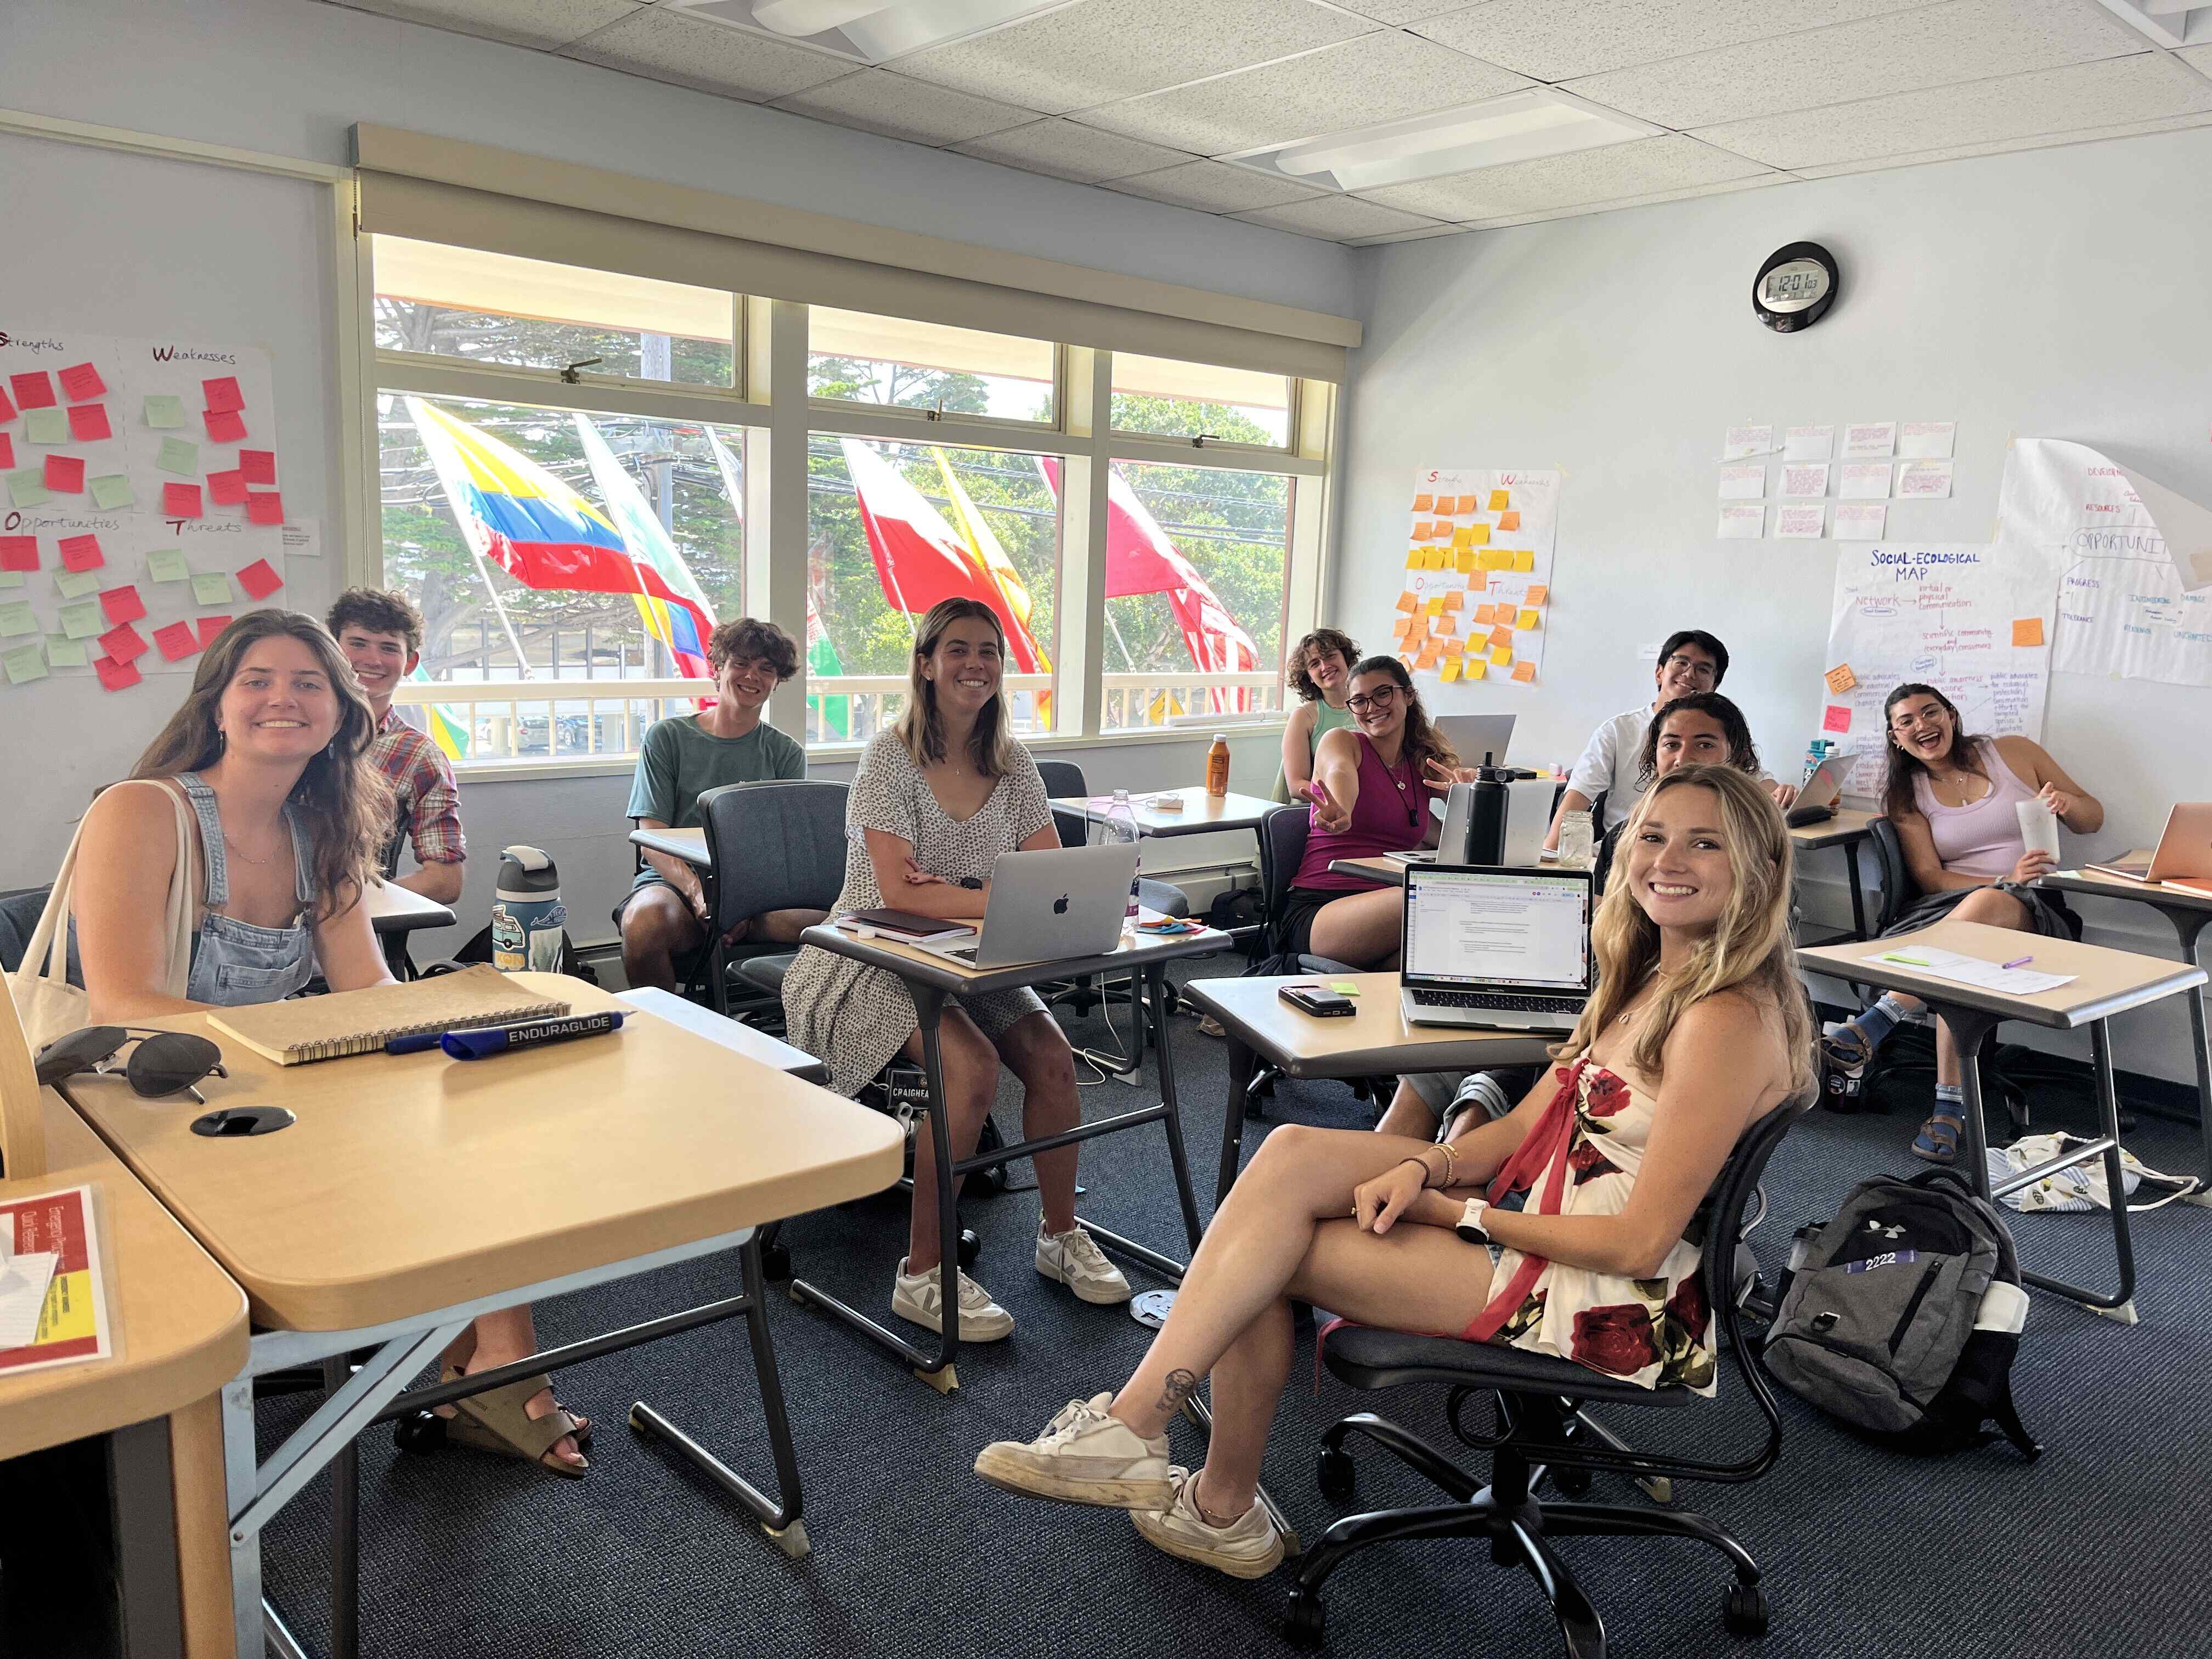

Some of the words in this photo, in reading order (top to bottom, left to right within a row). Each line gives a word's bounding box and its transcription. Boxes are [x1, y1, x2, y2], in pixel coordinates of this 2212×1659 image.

[153, 345, 236, 365] Weaknesses
[5, 511, 119, 537] Opportunities
[166, 520, 242, 536] Threats
[1871, 550, 1980, 566] SOCIAL-ECOLOGICAL
[1895, 567, 1928, 582] MAP
[509, 1017, 610, 1043] ENDURAGLIDE
[21, 1211, 38, 1228] Quick
